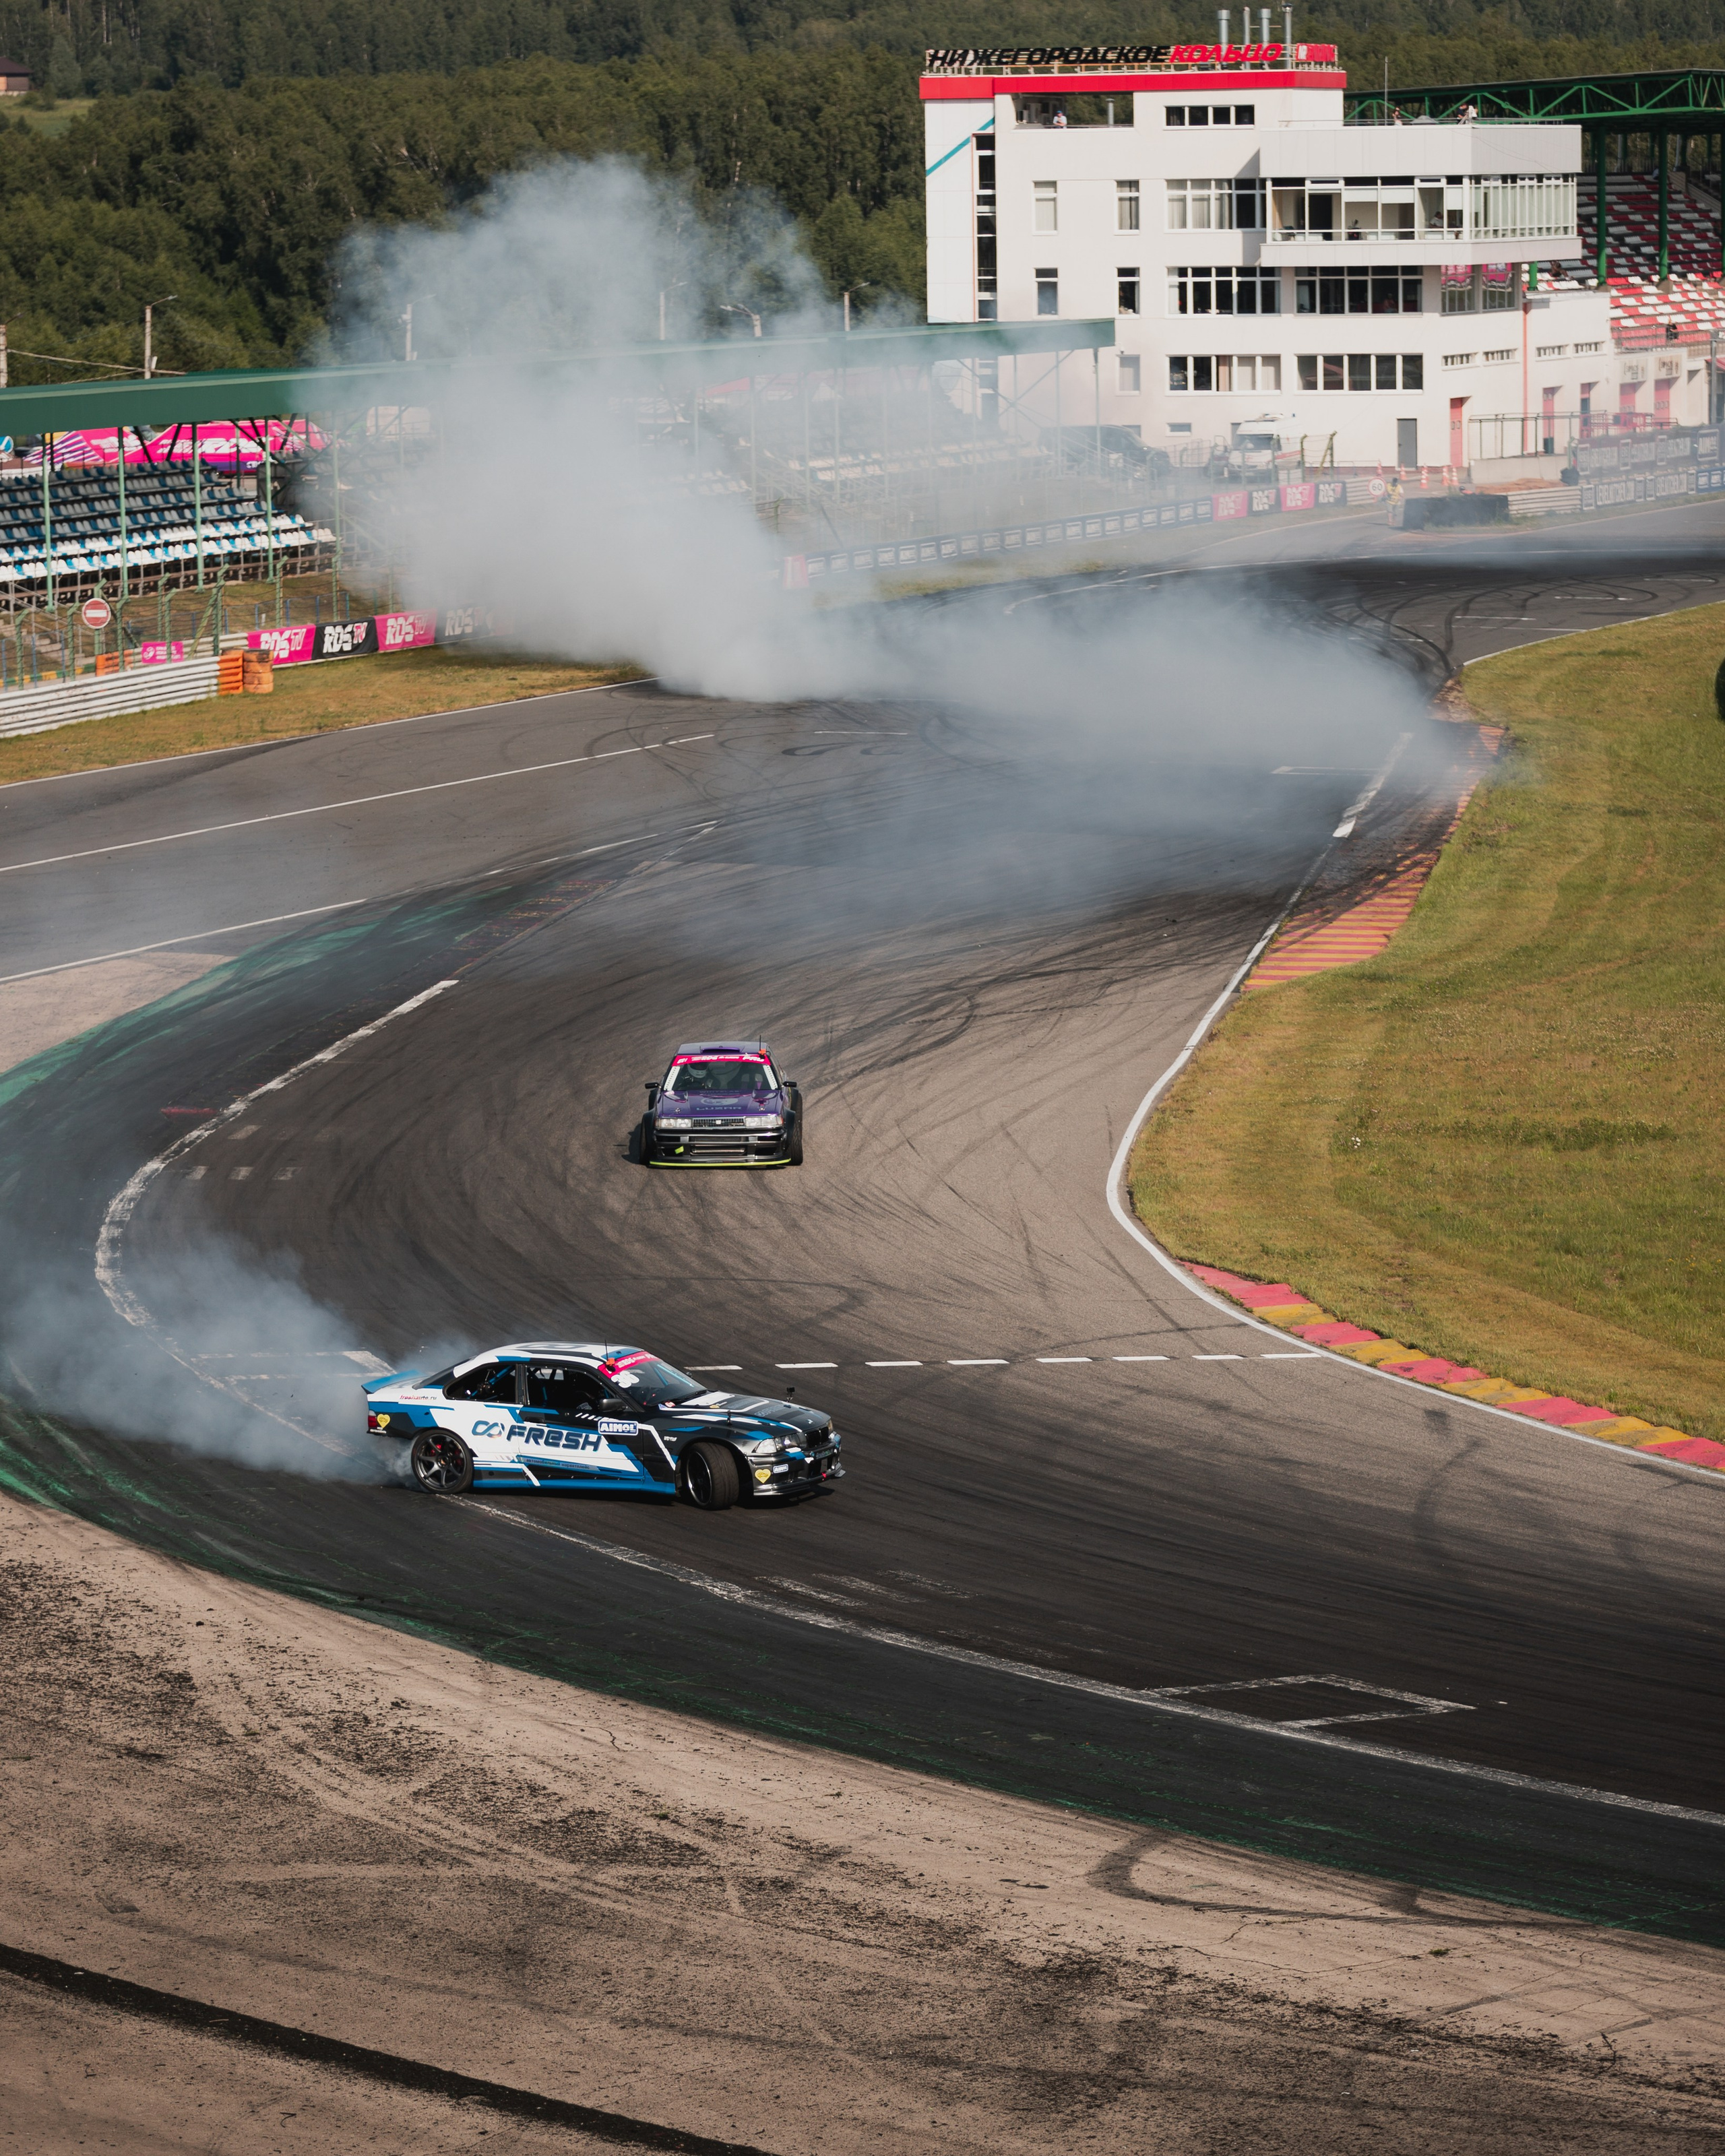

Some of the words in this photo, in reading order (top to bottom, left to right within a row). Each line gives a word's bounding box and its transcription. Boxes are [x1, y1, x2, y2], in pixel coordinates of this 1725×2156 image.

[929, 44, 1171, 67] НИЖЕГОРОДСКОЕ
[1169, 43, 1284, 63] КОЛЬЦО
[1371, 482, 1383, 491] 60
[610, 1370, 639, 1388] 36
[600, 1422, 637, 1434] AIMOL
